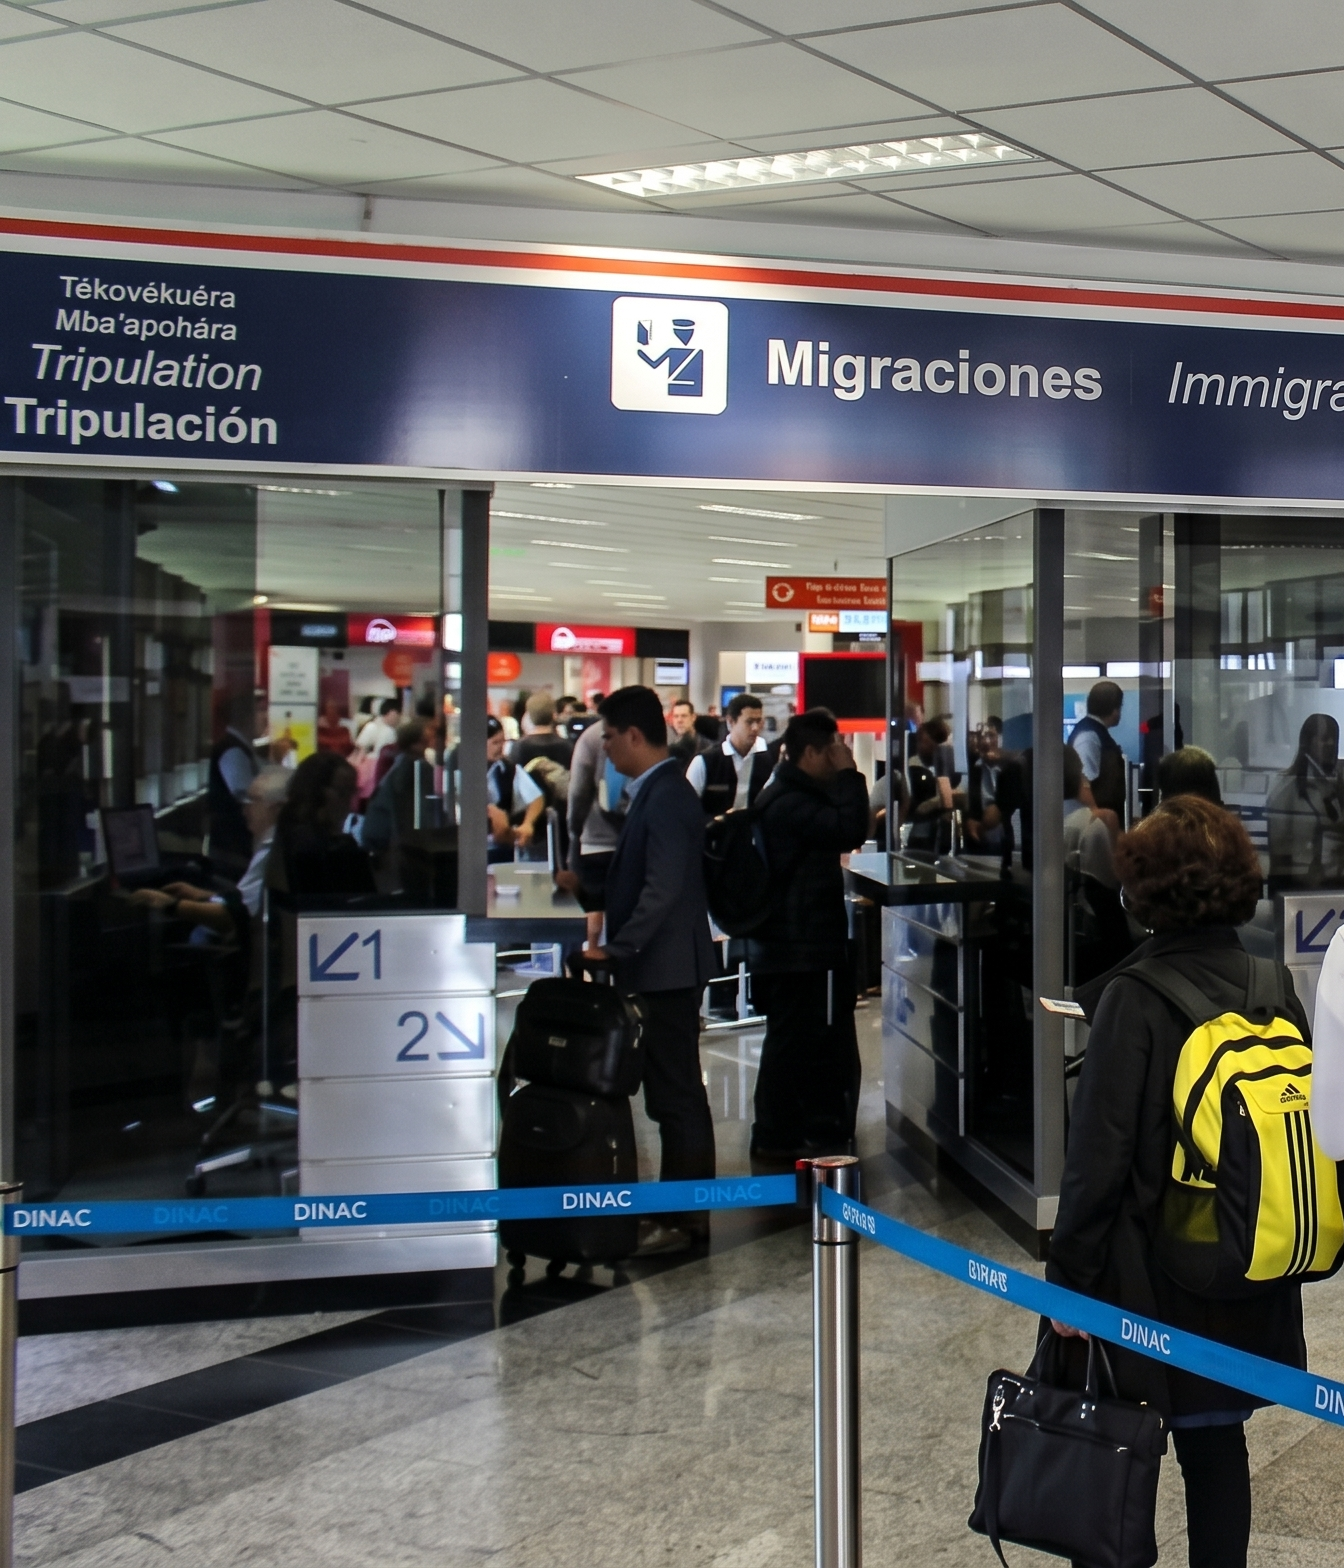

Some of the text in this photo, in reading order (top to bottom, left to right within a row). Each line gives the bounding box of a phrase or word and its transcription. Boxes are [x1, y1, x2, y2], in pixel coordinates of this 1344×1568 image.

[59, 275, 236, 308] Tékovékuéra
[55, 308, 237, 342] Mba'apohára
[31, 343, 262, 391] Tripulation
[768, 338, 1103, 401] Migraciones
[4, 396, 278, 446] Tripulación
[362, 928, 382, 980] 1
[396, 1010, 430, 1062] 2
[12, 1208, 92, 1230] DINAC
[293, 1201, 368, 1222] DINAC
[562, 1190, 632, 1211] DINAC
[1120, 1317, 1171, 1356] DINAC
